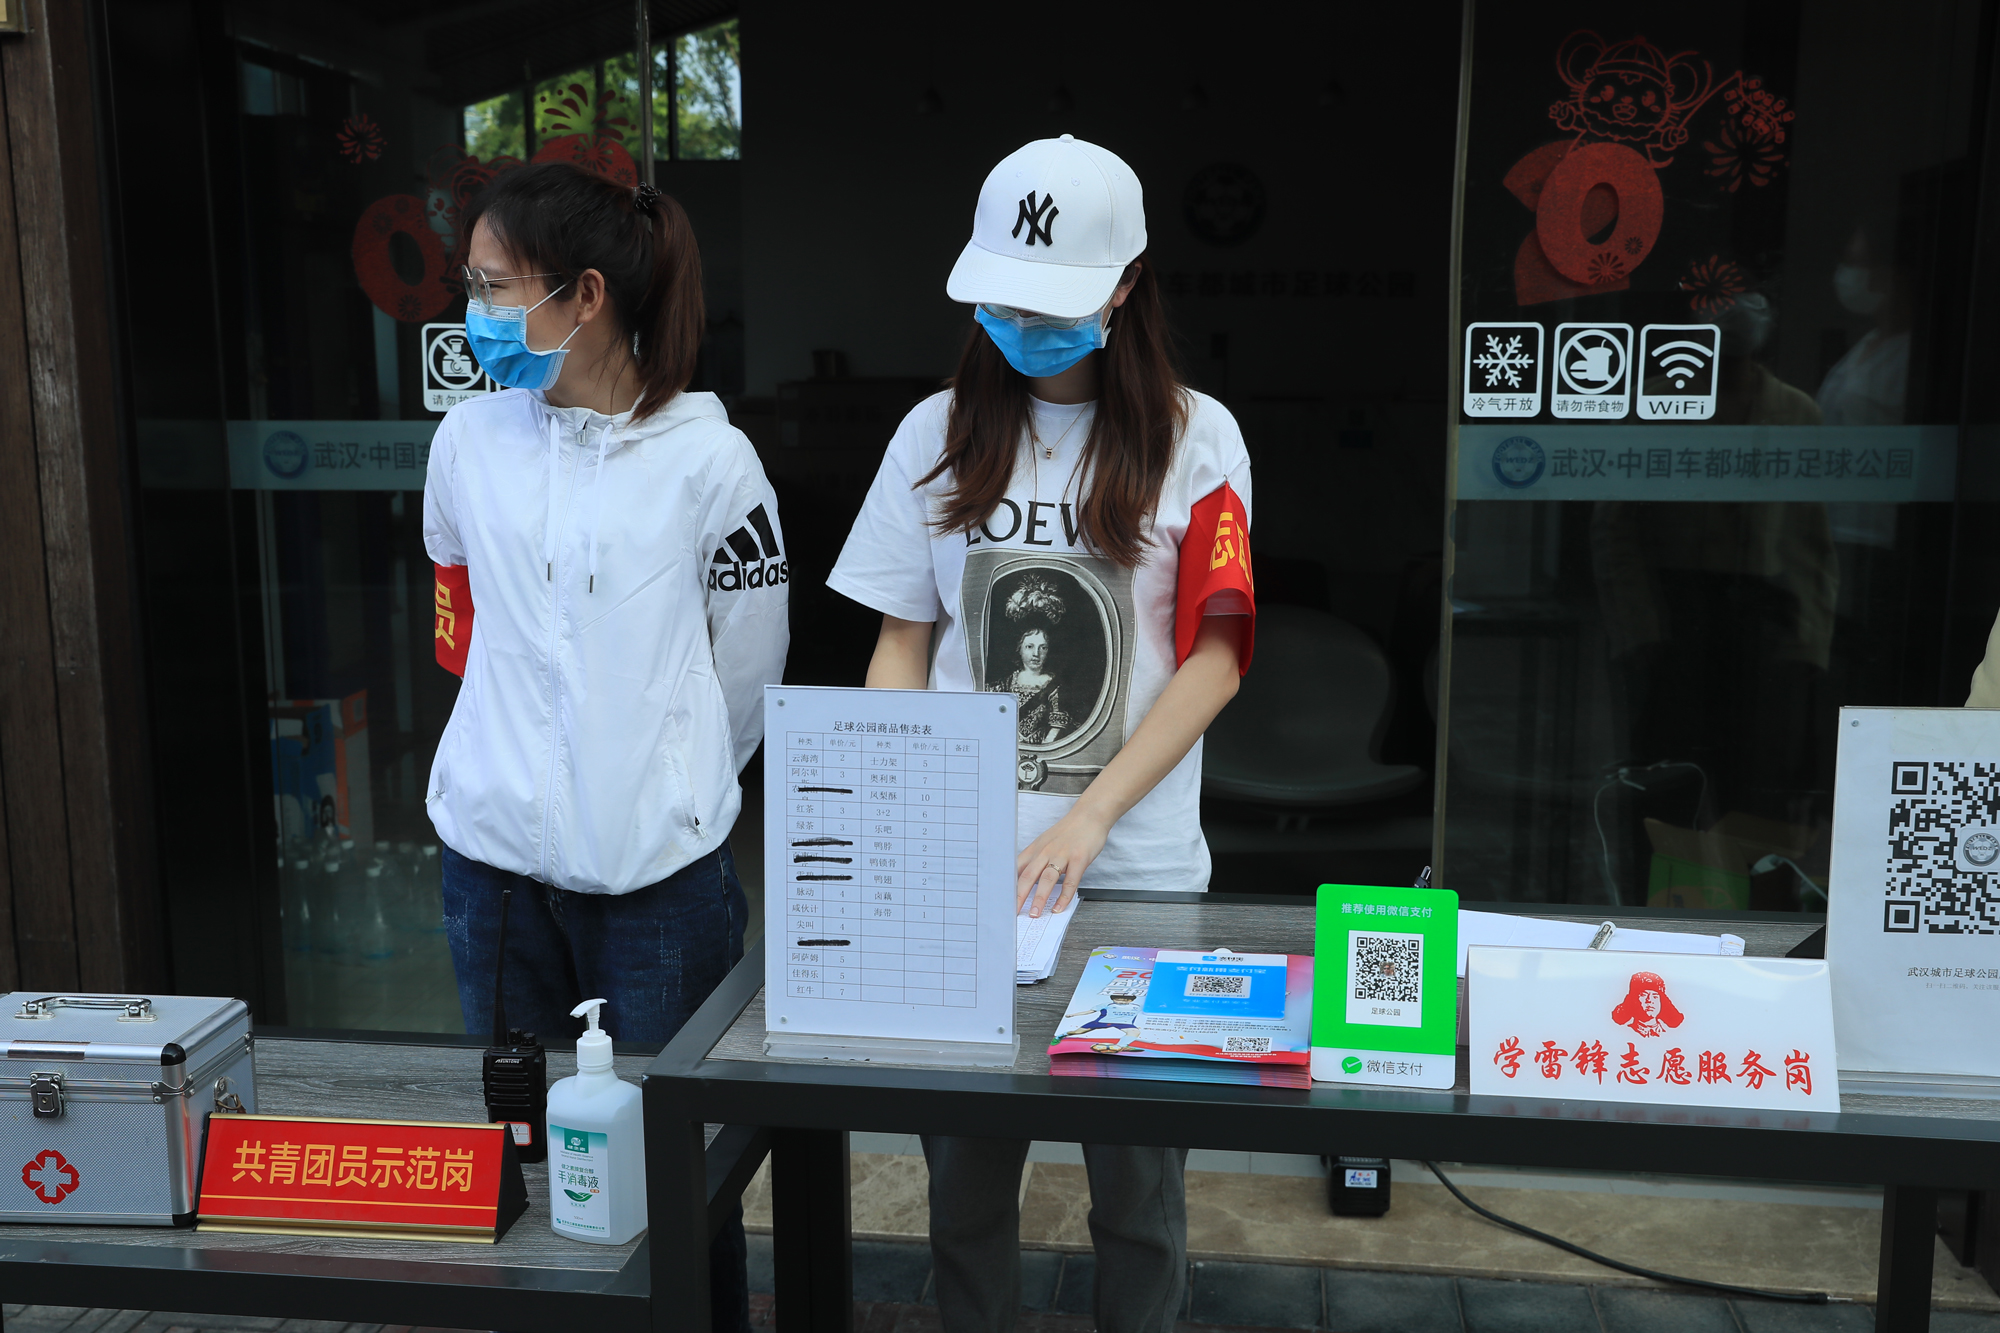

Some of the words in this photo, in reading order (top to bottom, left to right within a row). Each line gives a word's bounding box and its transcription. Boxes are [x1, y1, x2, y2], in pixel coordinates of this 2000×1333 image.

[1011, 189, 1060, 247] NY
[432, 394, 479, 406] 请勿拍
[1471, 396, 1534, 412] 冷气开放
[1556, 398, 1624, 414] 请勿带食物
[1648, 400, 1706, 416] WiFi
[1551, 446, 1915, 480] 武汉·中国车都城市足球公园
[708, 558, 789, 592] adidas
[833, 721, 932, 736] 足球公园商品售卖表
[798, 738, 813, 746] 种类
[829, 739, 856, 748] 单价/元
[876, 740, 892, 749] 种类
[912, 742, 940, 751] 单价/元
[955, 743, 971, 753] 备注
[792, 753, 819, 764] 云海湾
[840, 754, 845, 762] 2
[870, 756, 898, 767] 士力架
[923, 760, 928, 768] 5
[791, 767, 819, 778] 阿尔卑
[840, 770, 845, 778] 3
[870, 773, 898, 784] 奥利奥
[923, 776, 928, 785] 7
[920, 794, 931, 802] 10
[795, 804, 814, 814] 红茶
[840, 807, 845, 815] 3
[876, 808, 891, 817] 3+2
[922, 811, 928, 819] 6
[796, 820, 814, 830] 绿茶
[874, 825, 892, 834] 乐吧
[874, 841, 893, 851] 鸭脖
[922, 844, 927, 852] 2
[869, 858, 897, 868] 鸭锁骨
[922, 861, 927, 869] 2
[874, 875, 893, 885] 鸭翅
[922, 878, 927, 886] 2
[796, 887, 815, 897] 脉动
[839, 890, 845, 898] 4
[922, 894, 927, 902] 1
[839, 906, 845, 914] 4
[874, 908, 892, 918] 海带
[922, 911, 927, 919] 1
[1341, 902, 1433, 919] 推荐使用微信支付
[796, 920, 814, 930] 尖叫
[839, 923, 845, 931] 4
[791, 953, 819, 963] 阿萨姆
[840, 955, 845, 963] 5
[792, 969, 819, 979] 佳得乐
[840, 972, 845, 980] 5
[1907, 967, 2000, 979] 武汉城市足球公园
[796, 985, 814, 995] 红牛
[840, 988, 845, 996] 7
[1370, 1006, 1401, 1017] 足球公园
[1366, 1059, 1424, 1077] 微信支付
[1493, 1035, 1814, 1097] 学雷锋志愿服务岗
[231, 1139, 475, 1191] 共青团员示范岗
[558, 1170, 599, 1189] 手消毒液
